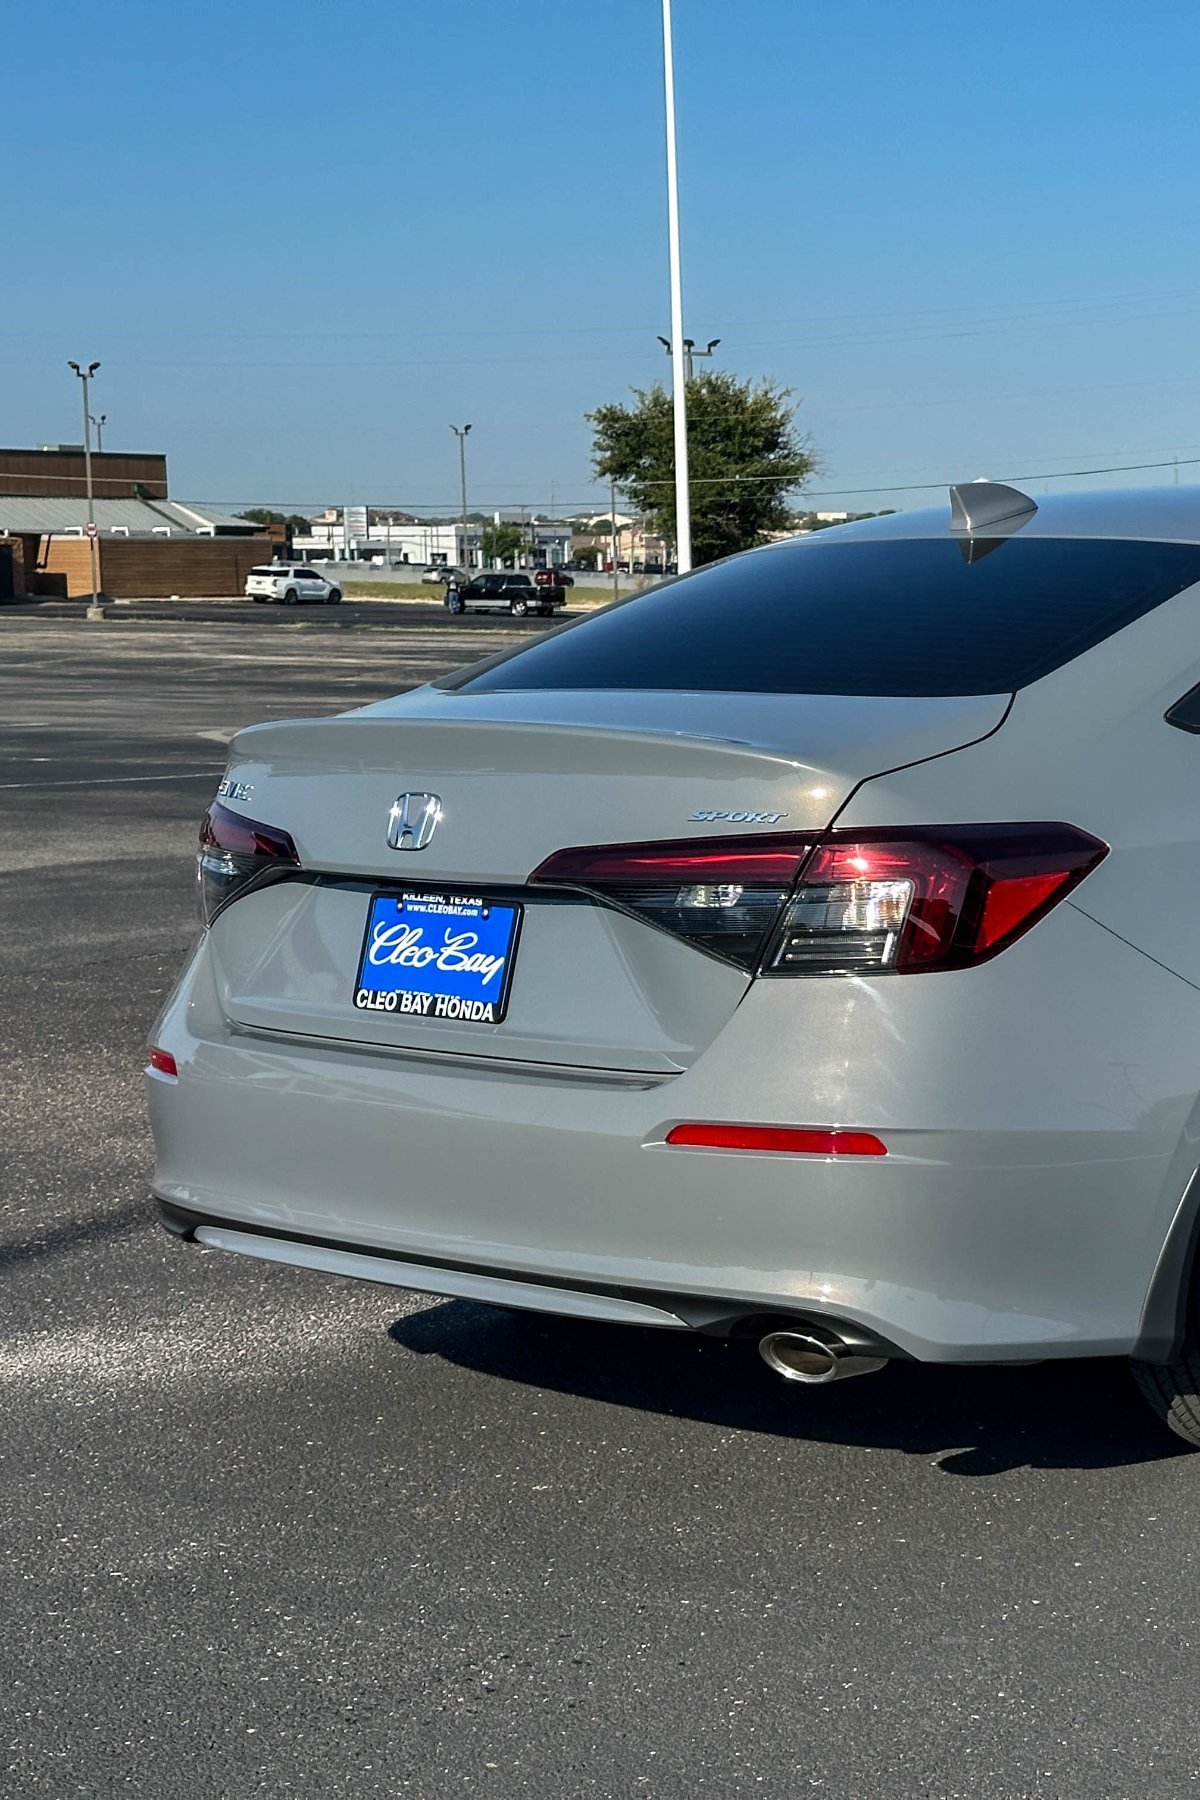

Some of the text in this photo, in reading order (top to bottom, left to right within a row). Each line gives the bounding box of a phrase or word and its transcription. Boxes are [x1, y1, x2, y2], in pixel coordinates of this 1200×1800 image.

[688, 810, 789, 824] SPORT
[402, 892, 483, 906] KILLEEN, TEXAS
[406, 903, 479, 917] www.CLEOBAY.com
[369, 920, 505, 986] Cleo Bay
[356, 989, 398, 1011] CLEO
[400, 993, 433, 1015] BAY
[435, 997, 494, 1022] HONDA
